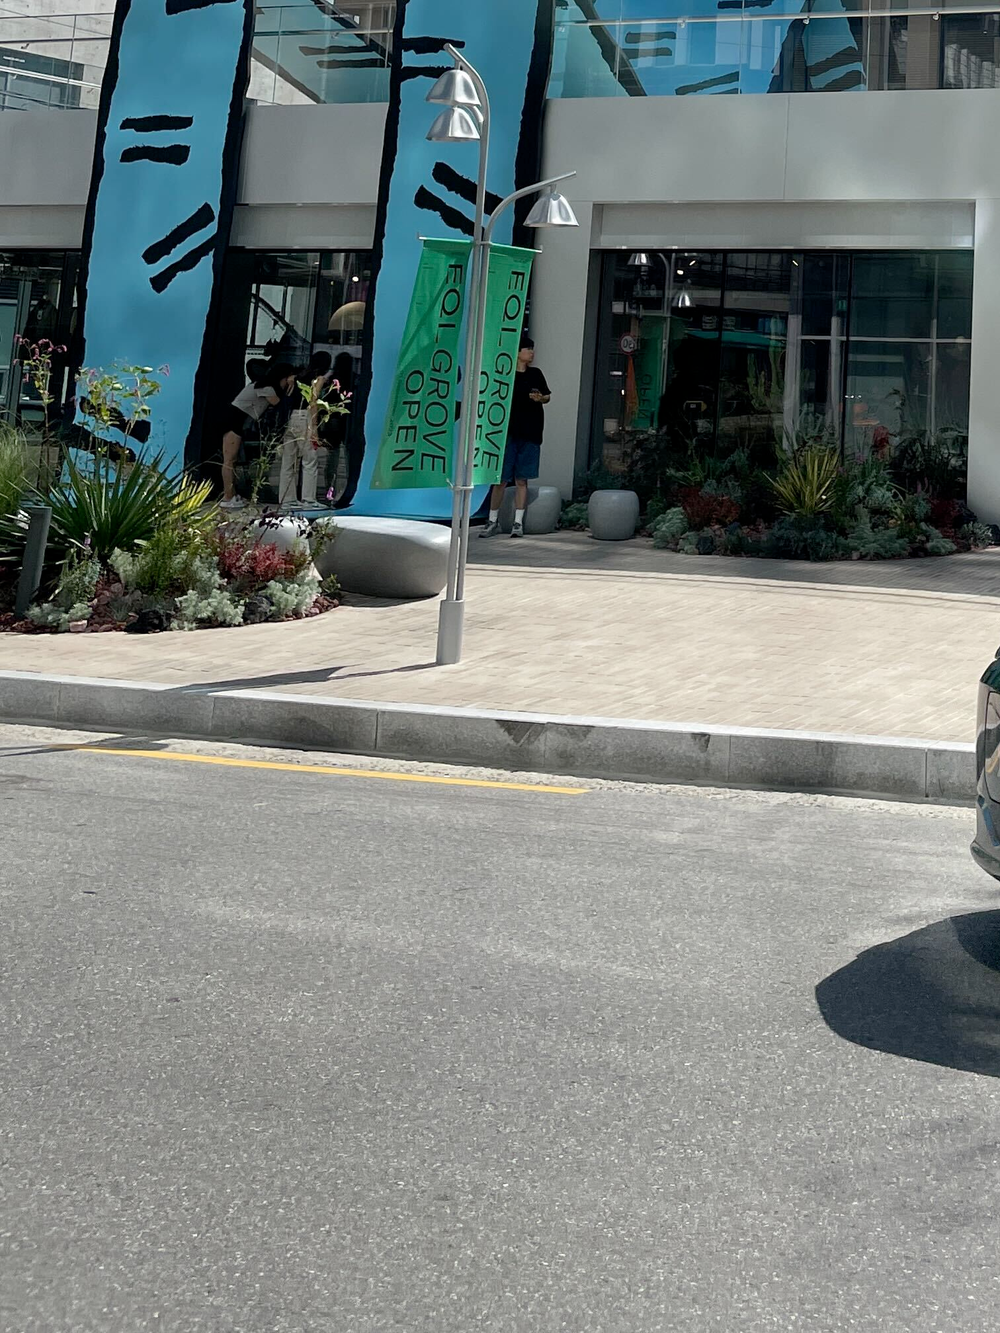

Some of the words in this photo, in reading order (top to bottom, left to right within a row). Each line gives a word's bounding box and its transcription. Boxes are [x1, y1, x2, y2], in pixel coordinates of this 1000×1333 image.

[435, 263, 463, 344] EQL
[498, 270, 526, 347] EQL
[391, 369, 425, 472] OPEN
[420, 349, 453, 474] GROVE
[480, 352, 513, 472] GROVE
